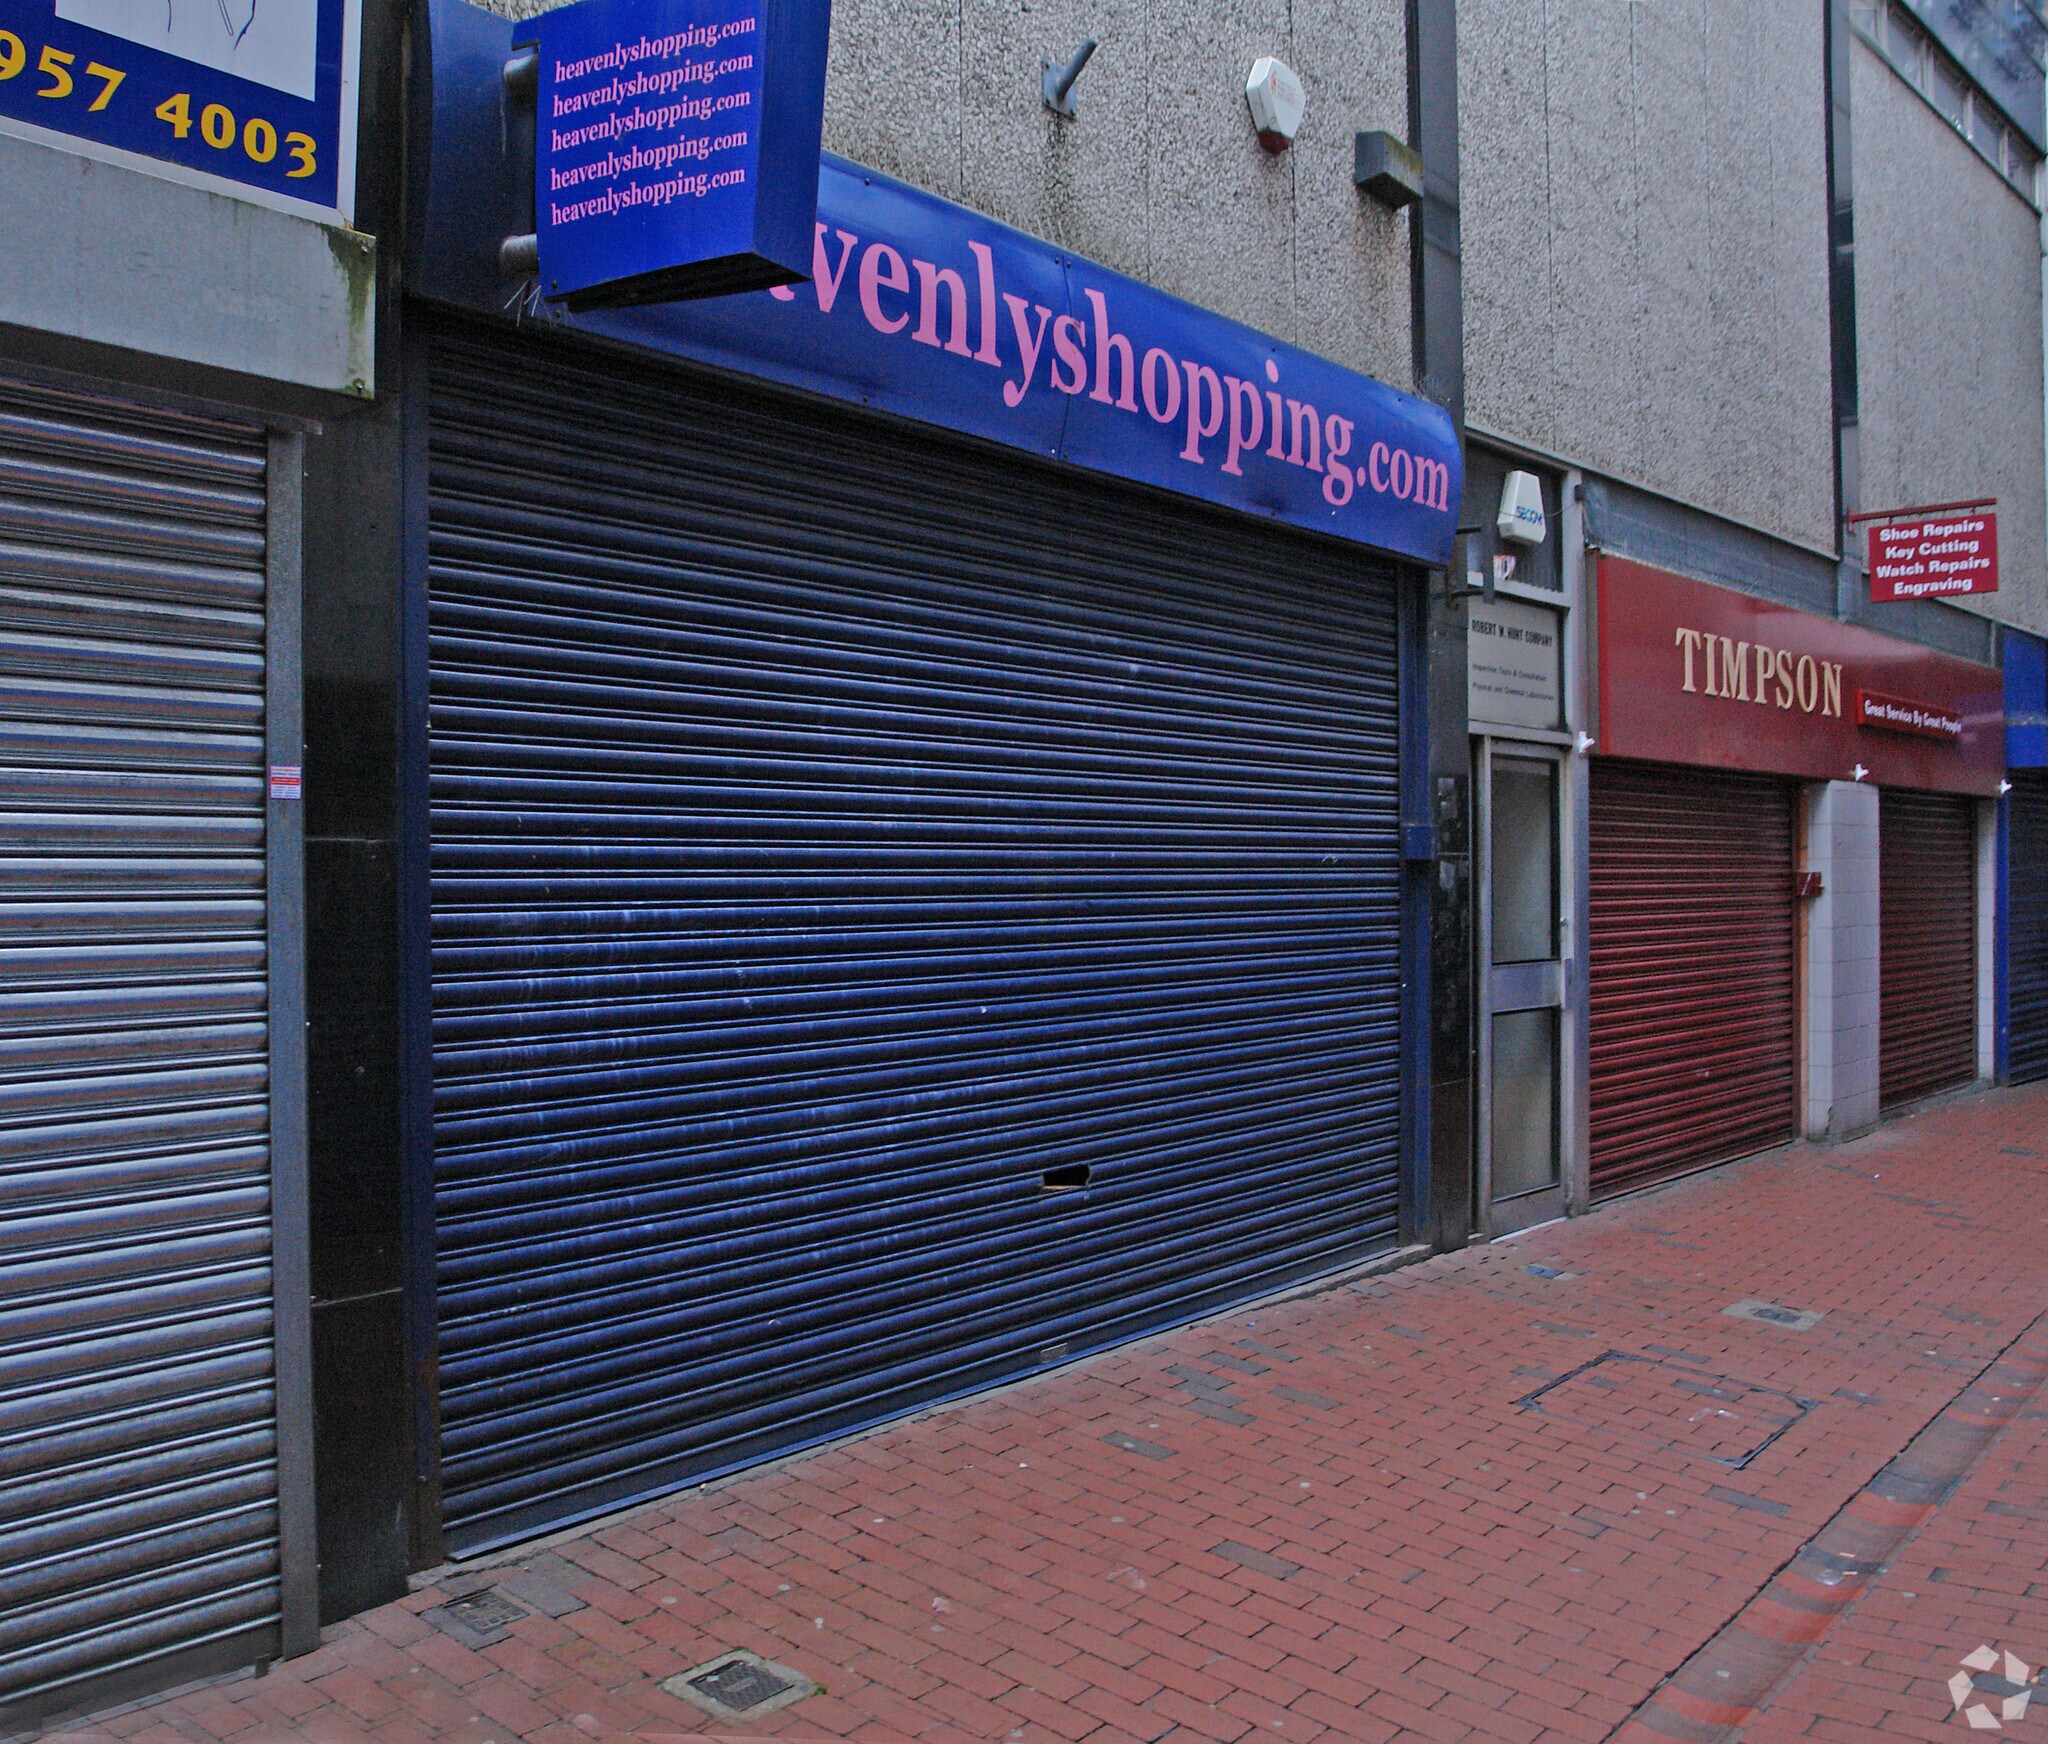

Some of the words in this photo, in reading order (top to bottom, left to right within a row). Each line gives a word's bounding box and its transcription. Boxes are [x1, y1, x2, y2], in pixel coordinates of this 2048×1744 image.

[554, 17, 756, 83] heavenlyshopping.com
[0, 29, 127, 112] 957
[155, 93, 317, 178] 4003
[553, 54, 754, 117] heavenlyshopping.com
[551, 91, 751, 152] heavenlyshopping.com
[550, 131, 748, 191] heavenlyshopping.com
[551, 168, 746, 226] heavenlyshopping.com
[769, 221, 1449, 512] venlyshopping.com
[1880, 528, 1919, 542] Shoe
[1923, 520, 1984, 537] Repairs
[1885, 546, 1915, 560] Key
[1918, 539, 1980, 555] Cutting
[1876, 562, 1925, 578] Watch
[1929, 556, 1990, 573] Repairs
[1894, 577, 1973, 596] Engraving
[1472, 619, 1497, 636] ROBERT
[1525, 630, 1552, 647] COMPANY
[1676, 627, 1843, 718] TIMPSON
[1865, 699, 1885, 718] Great
[1886, 704, 1912, 723] Service
[1913, 710, 1922, 728] By
[1923, 712, 1940, 728] Great
